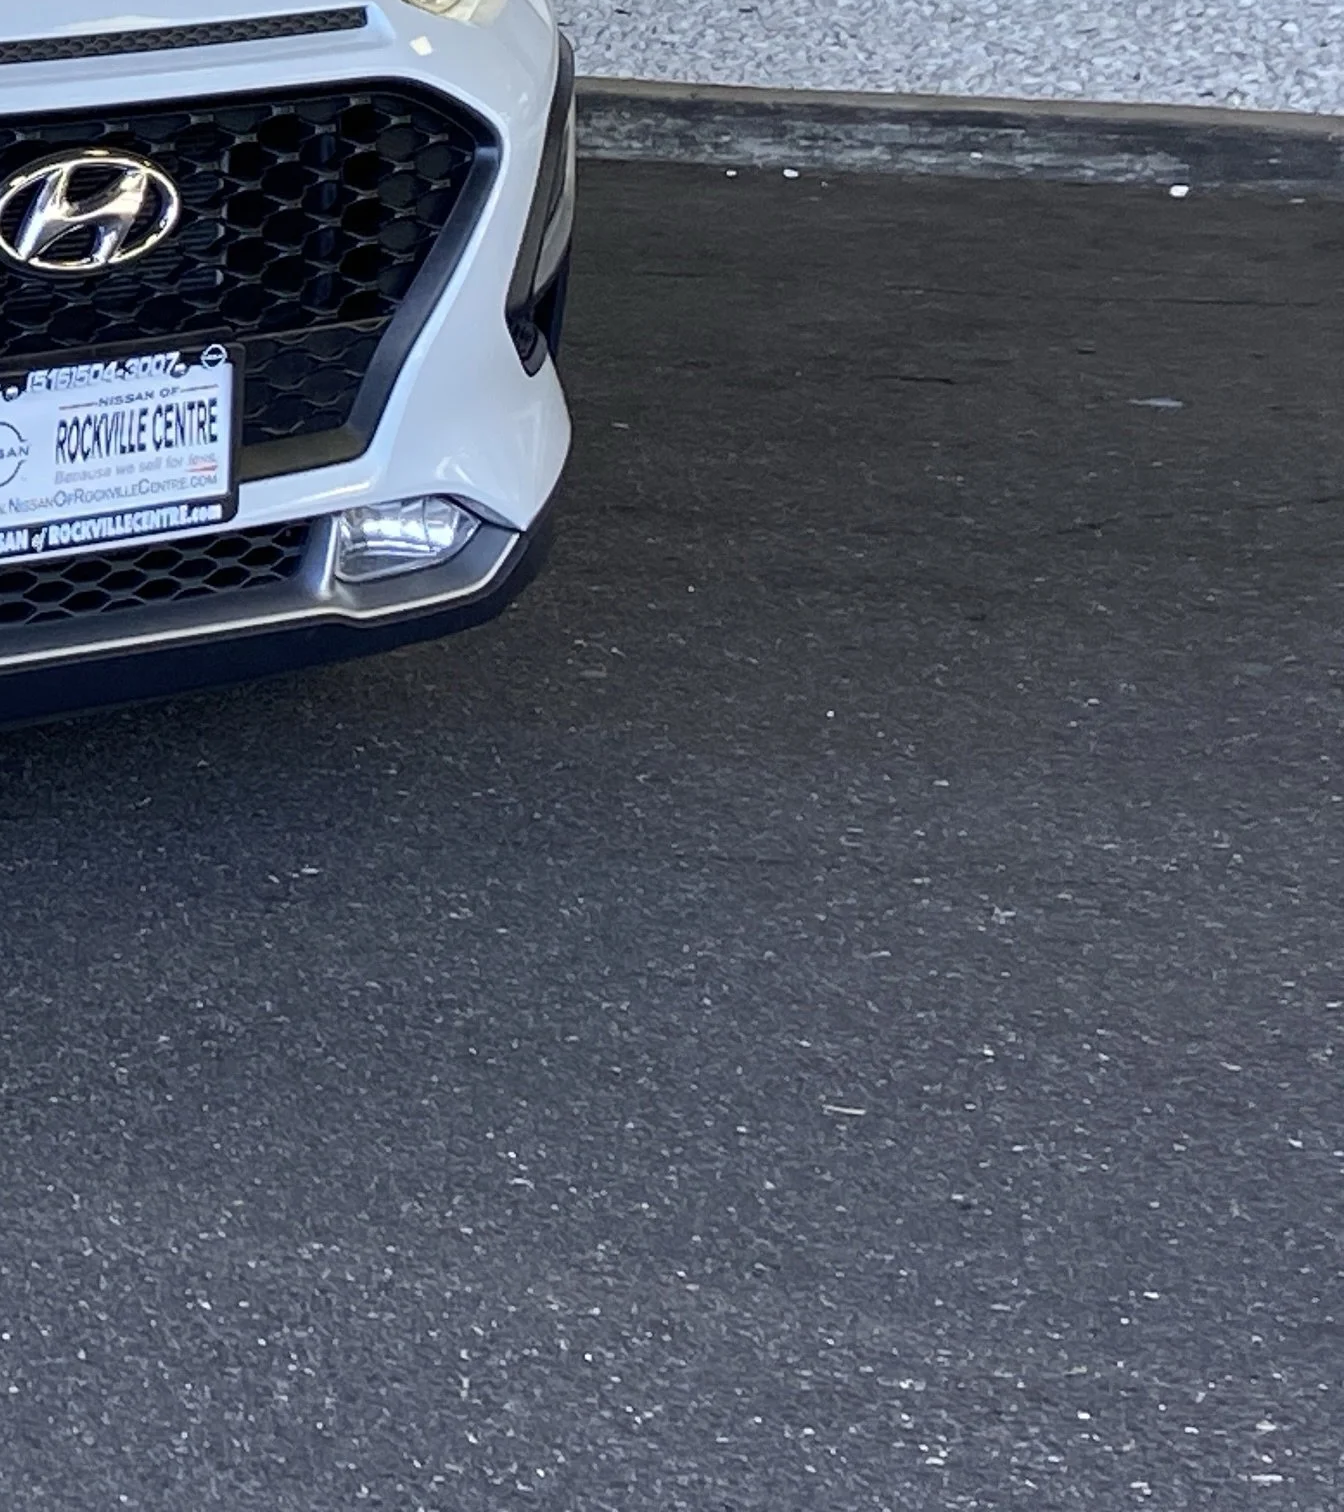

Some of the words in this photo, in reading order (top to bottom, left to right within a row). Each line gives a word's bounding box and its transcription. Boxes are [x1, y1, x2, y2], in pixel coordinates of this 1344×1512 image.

[98, 390, 155, 407] NISSAN
[55, 407, 149, 464] ROCKVILLE
[152, 397, 218, 452] CENTRE
